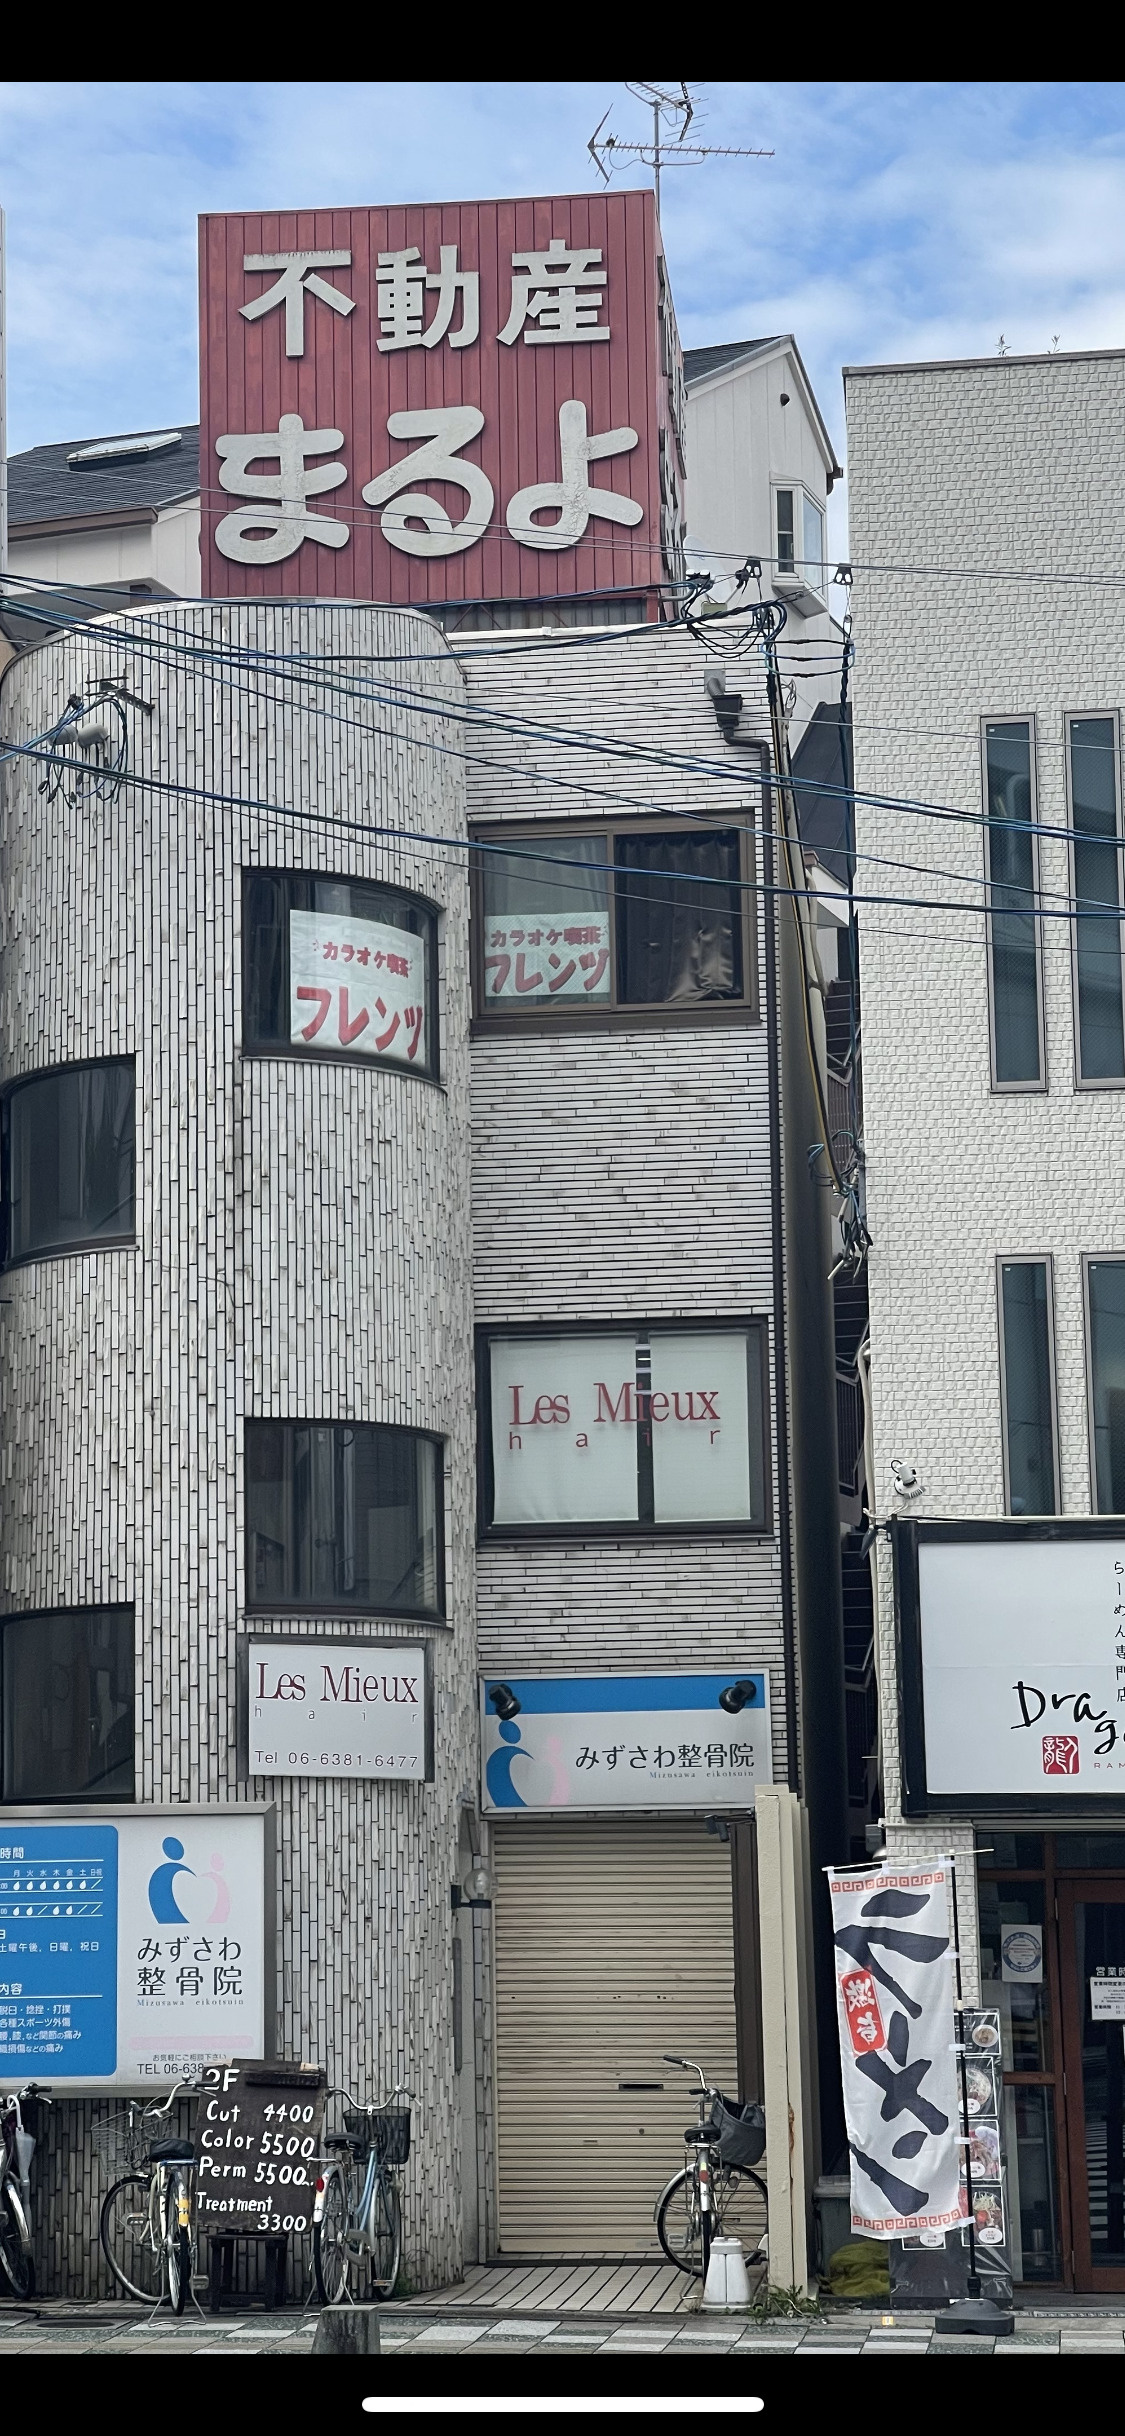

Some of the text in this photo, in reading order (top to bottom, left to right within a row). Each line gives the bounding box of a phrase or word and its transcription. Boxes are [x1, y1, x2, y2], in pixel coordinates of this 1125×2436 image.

[237, 239, 611, 358] 不動産
[214, 399, 644, 565] まるよ
[491, 926, 601, 947] カラオケ喫茶
[323, 942, 408, 978] カラオケ喫茶
[508, 1382, 720, 1425] Les Mieux
[255, 1662, 419, 1703] Les Mieux
[1010, 1681, 1125, 1755] Drag
[254, 1750, 418, 1768] Tel 06-6381-6477
[575, 1743, 755, 1771] みずさわ整骨院
[0, 1847, 24, 1859] 時間
[13, 1869, 20, 1877] 月
[26, 1869, 34, 1877] 火
[79, 1868, 87, 1876] 土
[137, 1936, 242, 1963] みずさわ
[0, 1983, 22, 1995] 内容
[137, 1966, 243, 1997] 整骨院
[137, 2063, 161, 2075] TEL
[204, 2068, 240, 2092] 2F
[206, 2100, 314, 2124] Cut 4400
[201, 2128, 255, 2150] Color
[199, 2156, 247, 2178] Perm
[195, 2191, 273, 2213] Treatment
[257, 2214, 307, 2232] 3300
